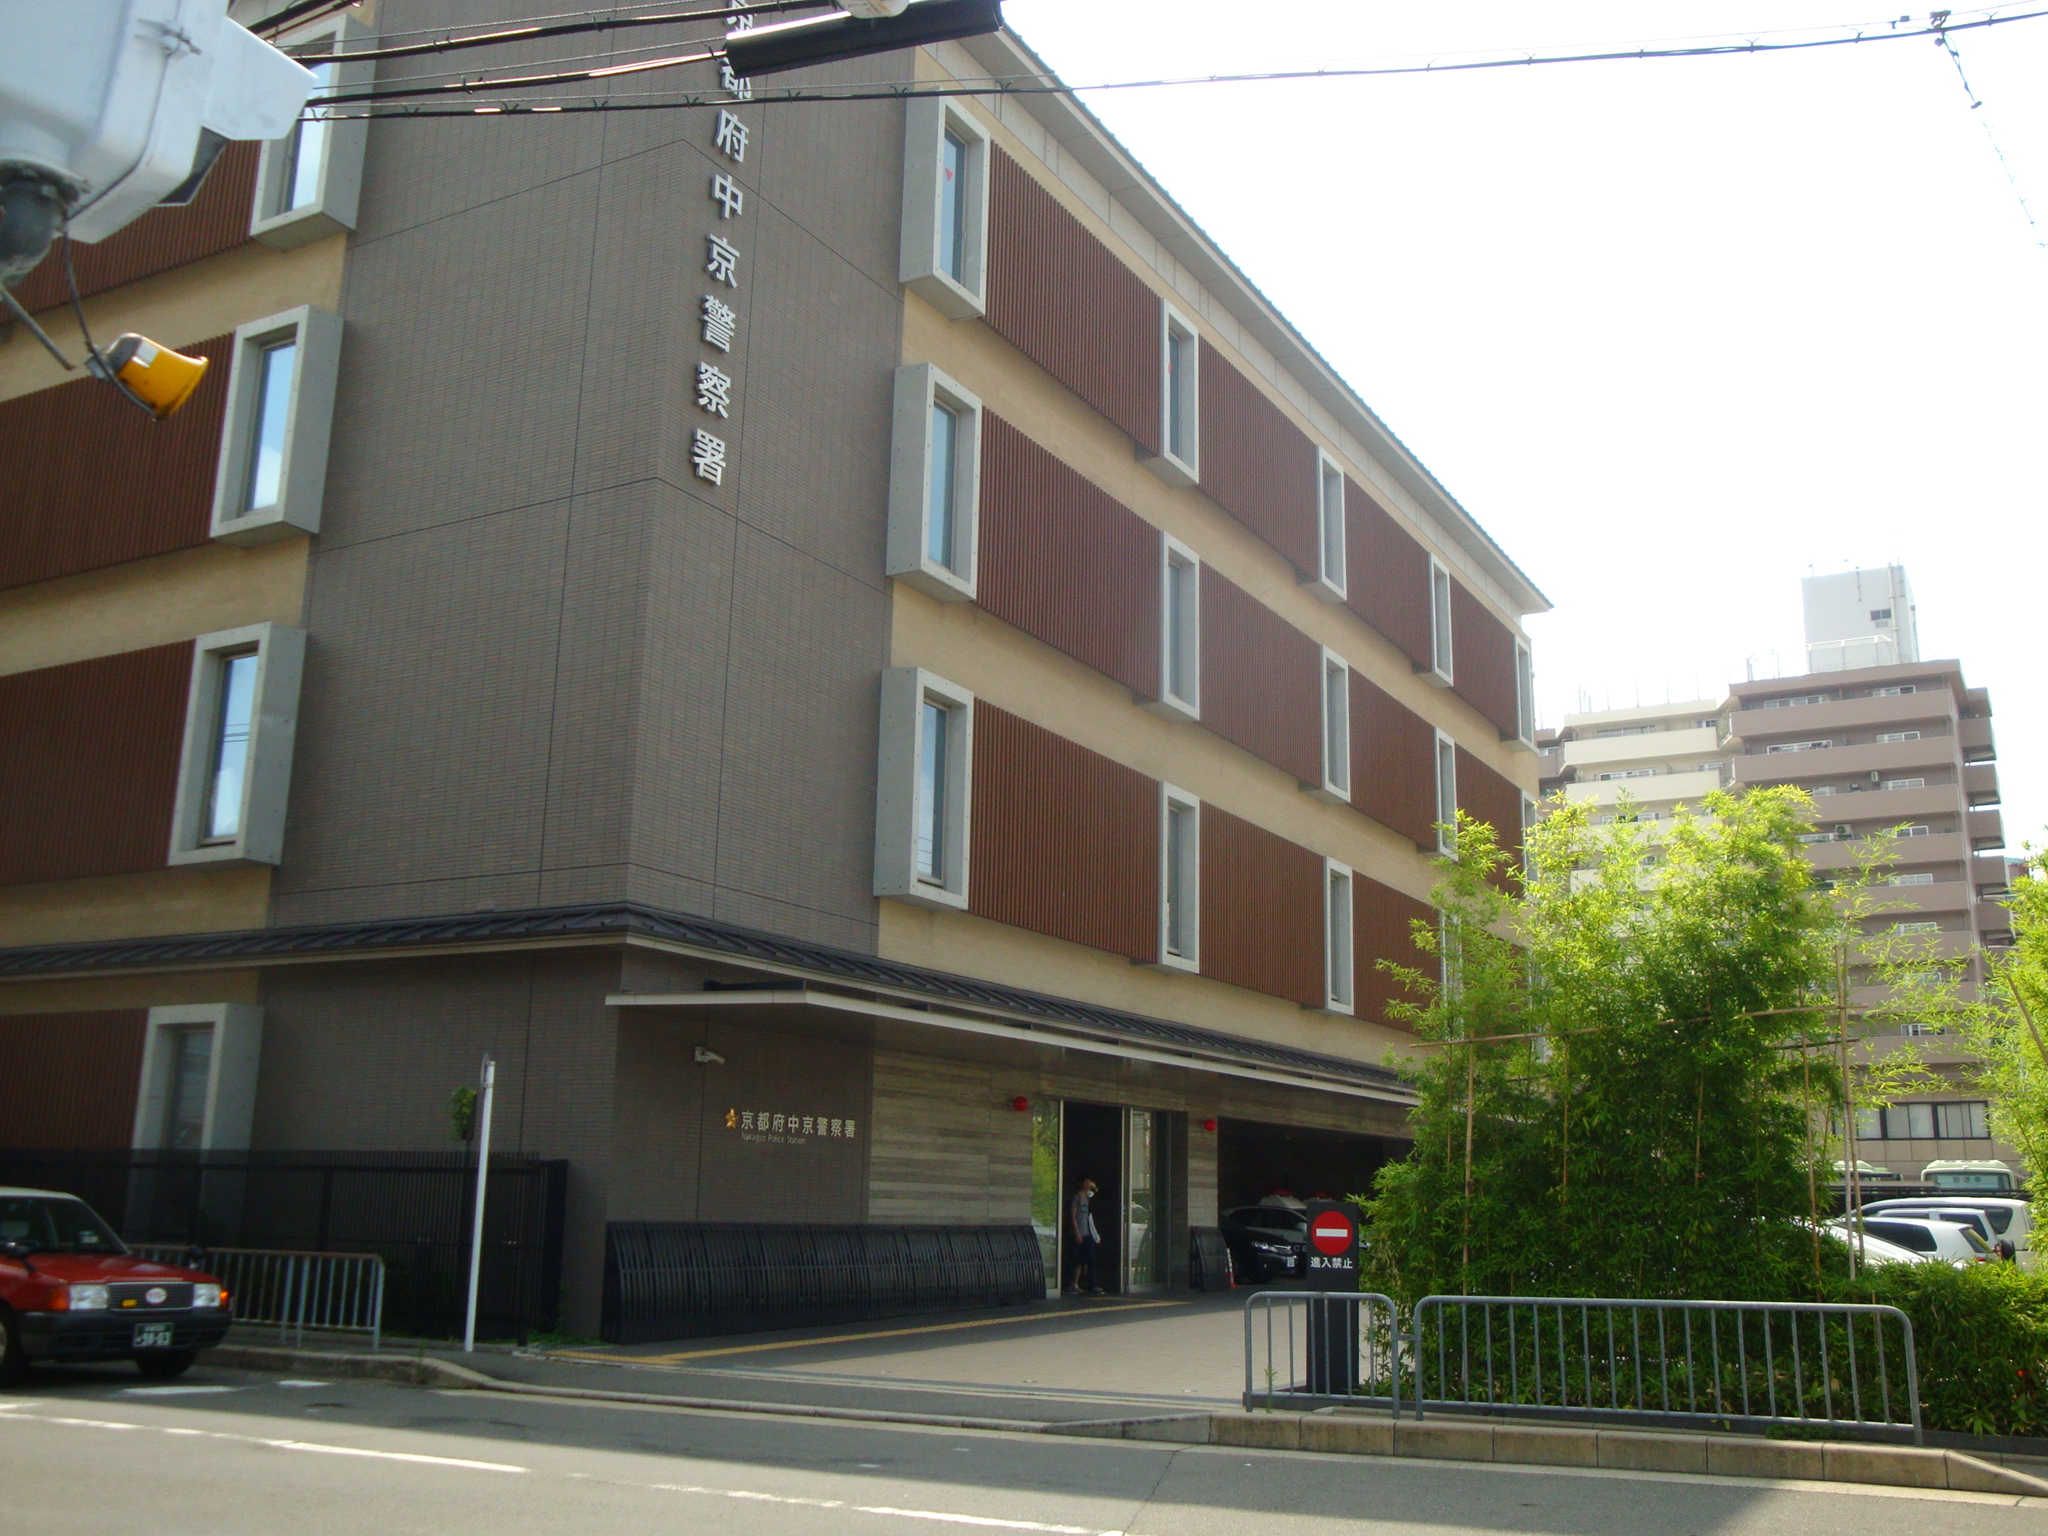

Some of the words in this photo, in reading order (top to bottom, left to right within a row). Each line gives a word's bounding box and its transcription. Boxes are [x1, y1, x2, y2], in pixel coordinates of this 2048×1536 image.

[740, 1110, 856, 1138] 京都府中京警察署
[741, 1132, 765, 1144] Nakagyo
[768, 1134, 785, 1143] Police
[787, 1135, 806, 1144] Station
[1310, 1256, 1353, 1269] 進入禁止
